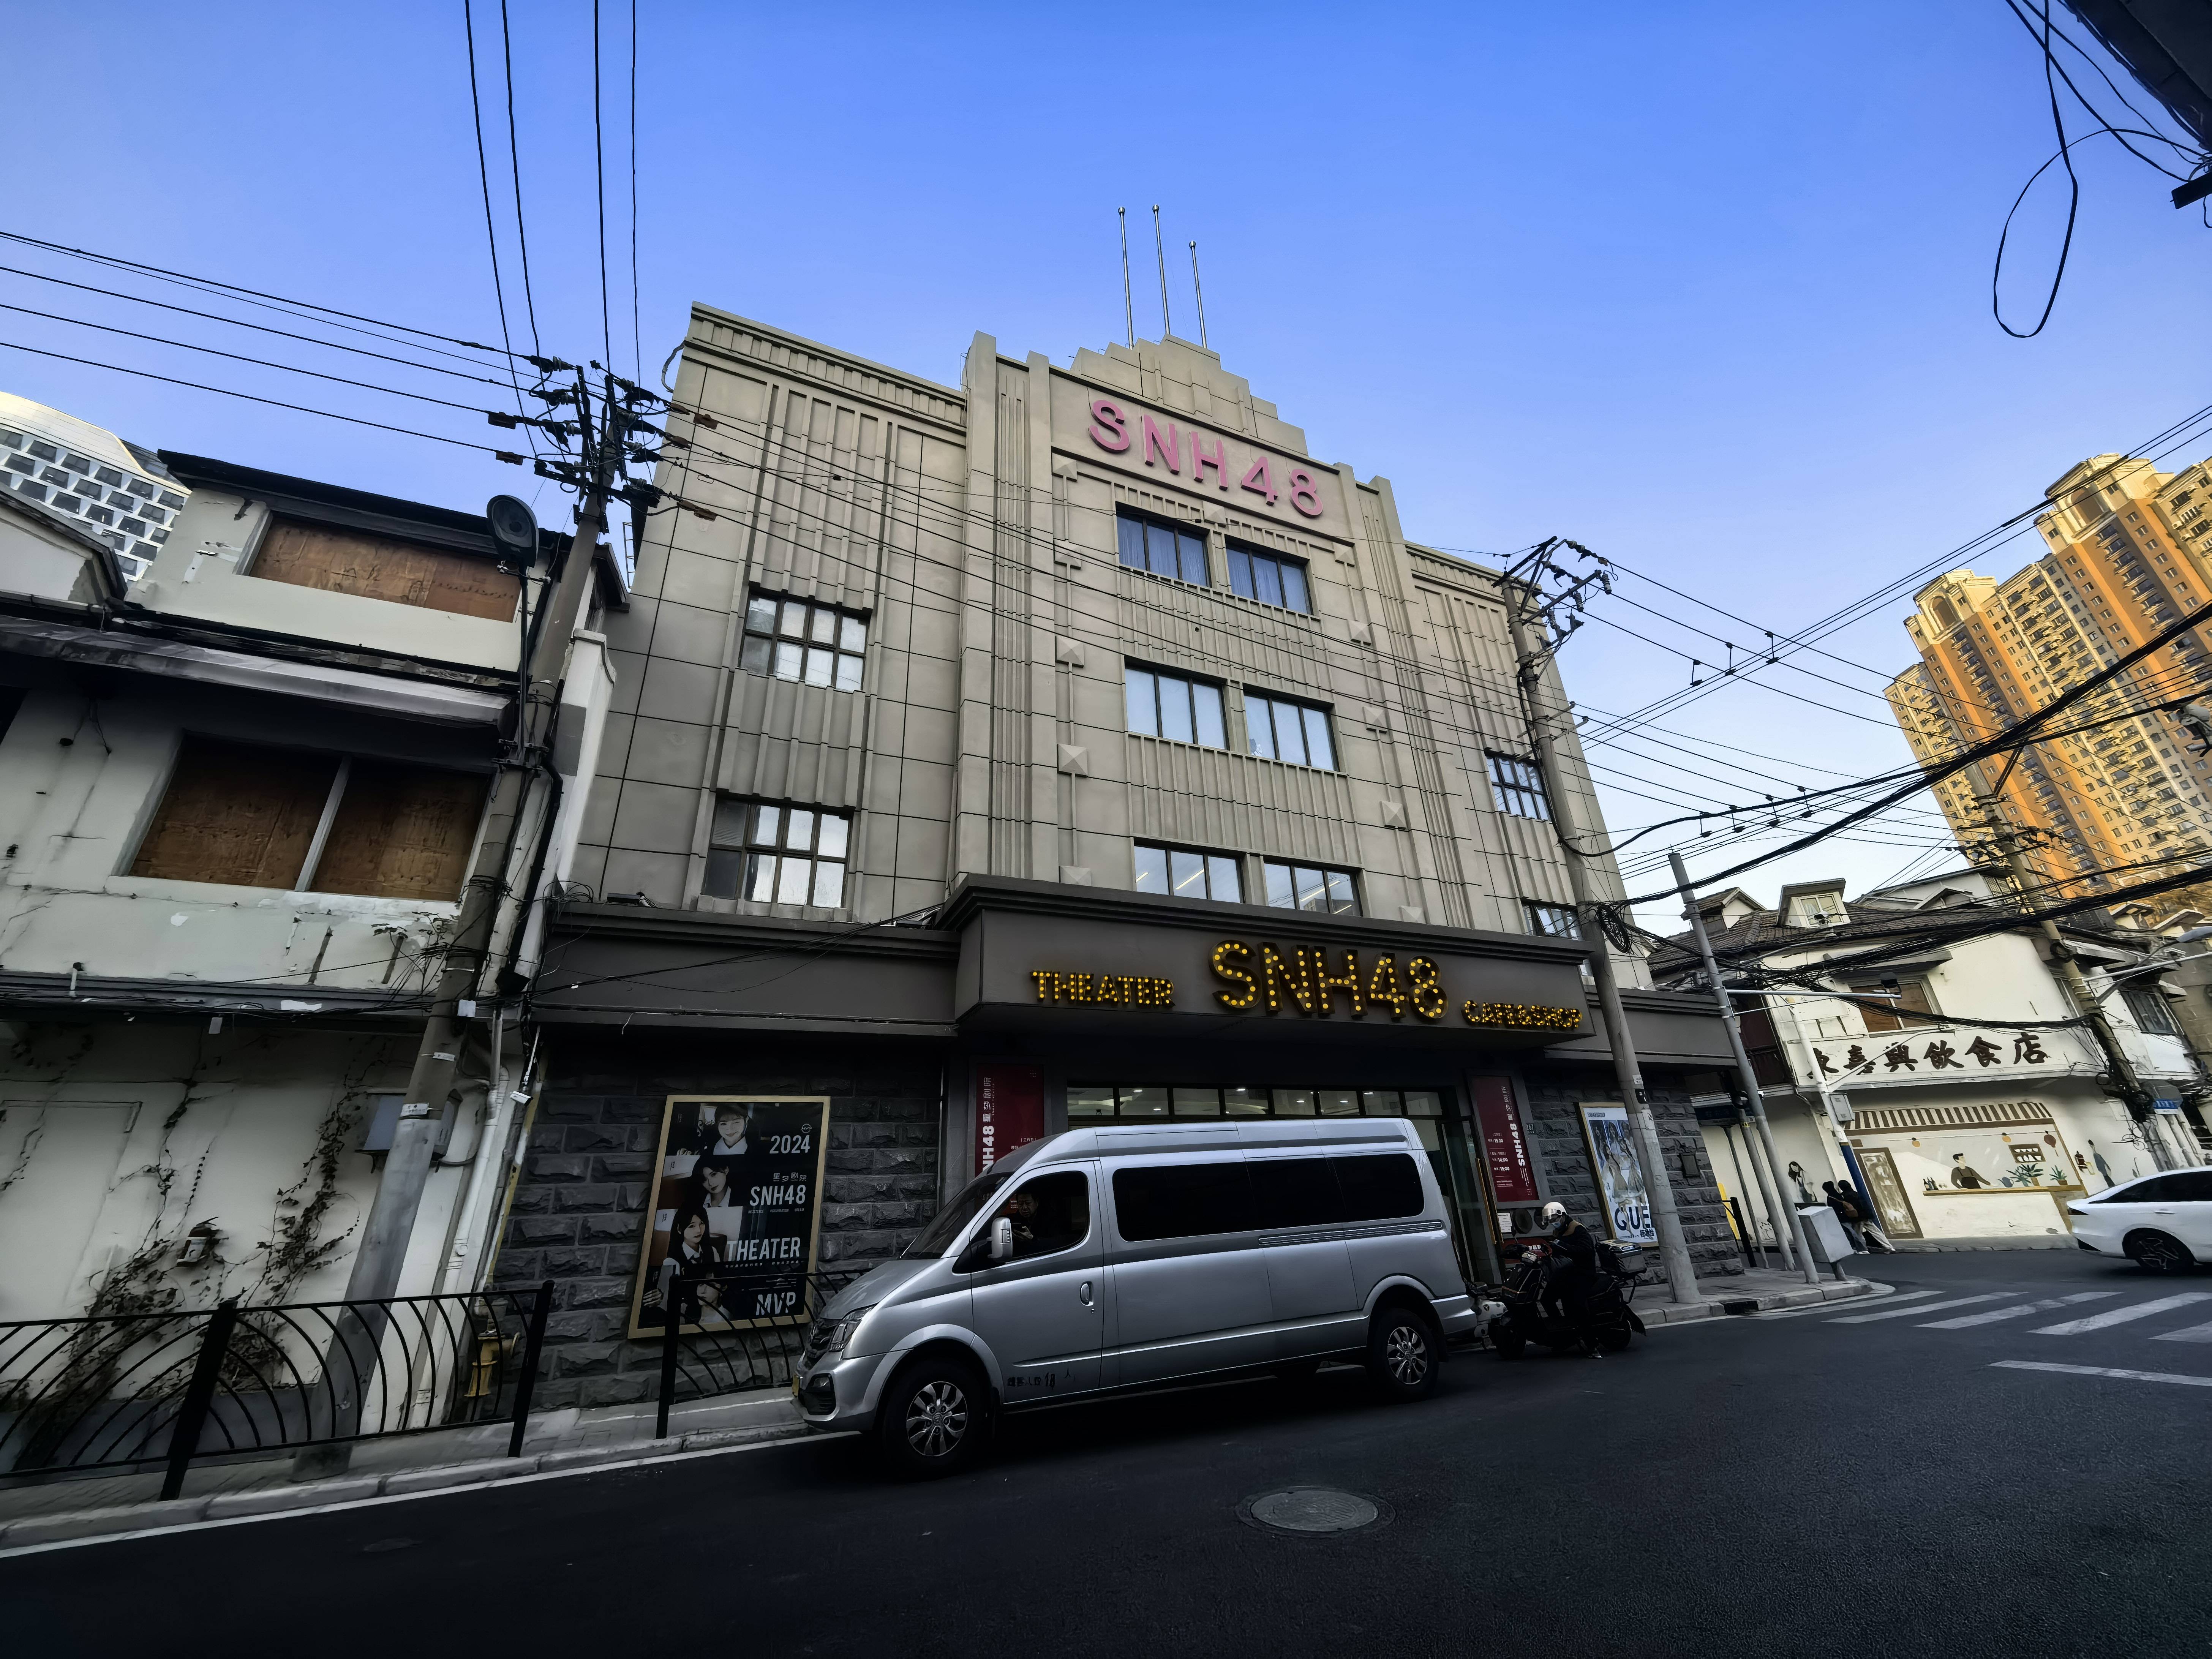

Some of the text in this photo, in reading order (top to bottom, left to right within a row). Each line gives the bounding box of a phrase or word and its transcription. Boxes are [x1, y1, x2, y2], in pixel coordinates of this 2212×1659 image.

[1088, 400, 1323, 518] SNH48
[1030, 970, 1176, 1008] THEATER
[1208, 939, 1448, 1021] SNH48
[769, 1135, 810, 1154] 2024
[1510, 1123, 1526, 1166] SNH48
[749, 1185, 806, 1206] SNH48
[725, 1237, 801, 1262] THEATER
